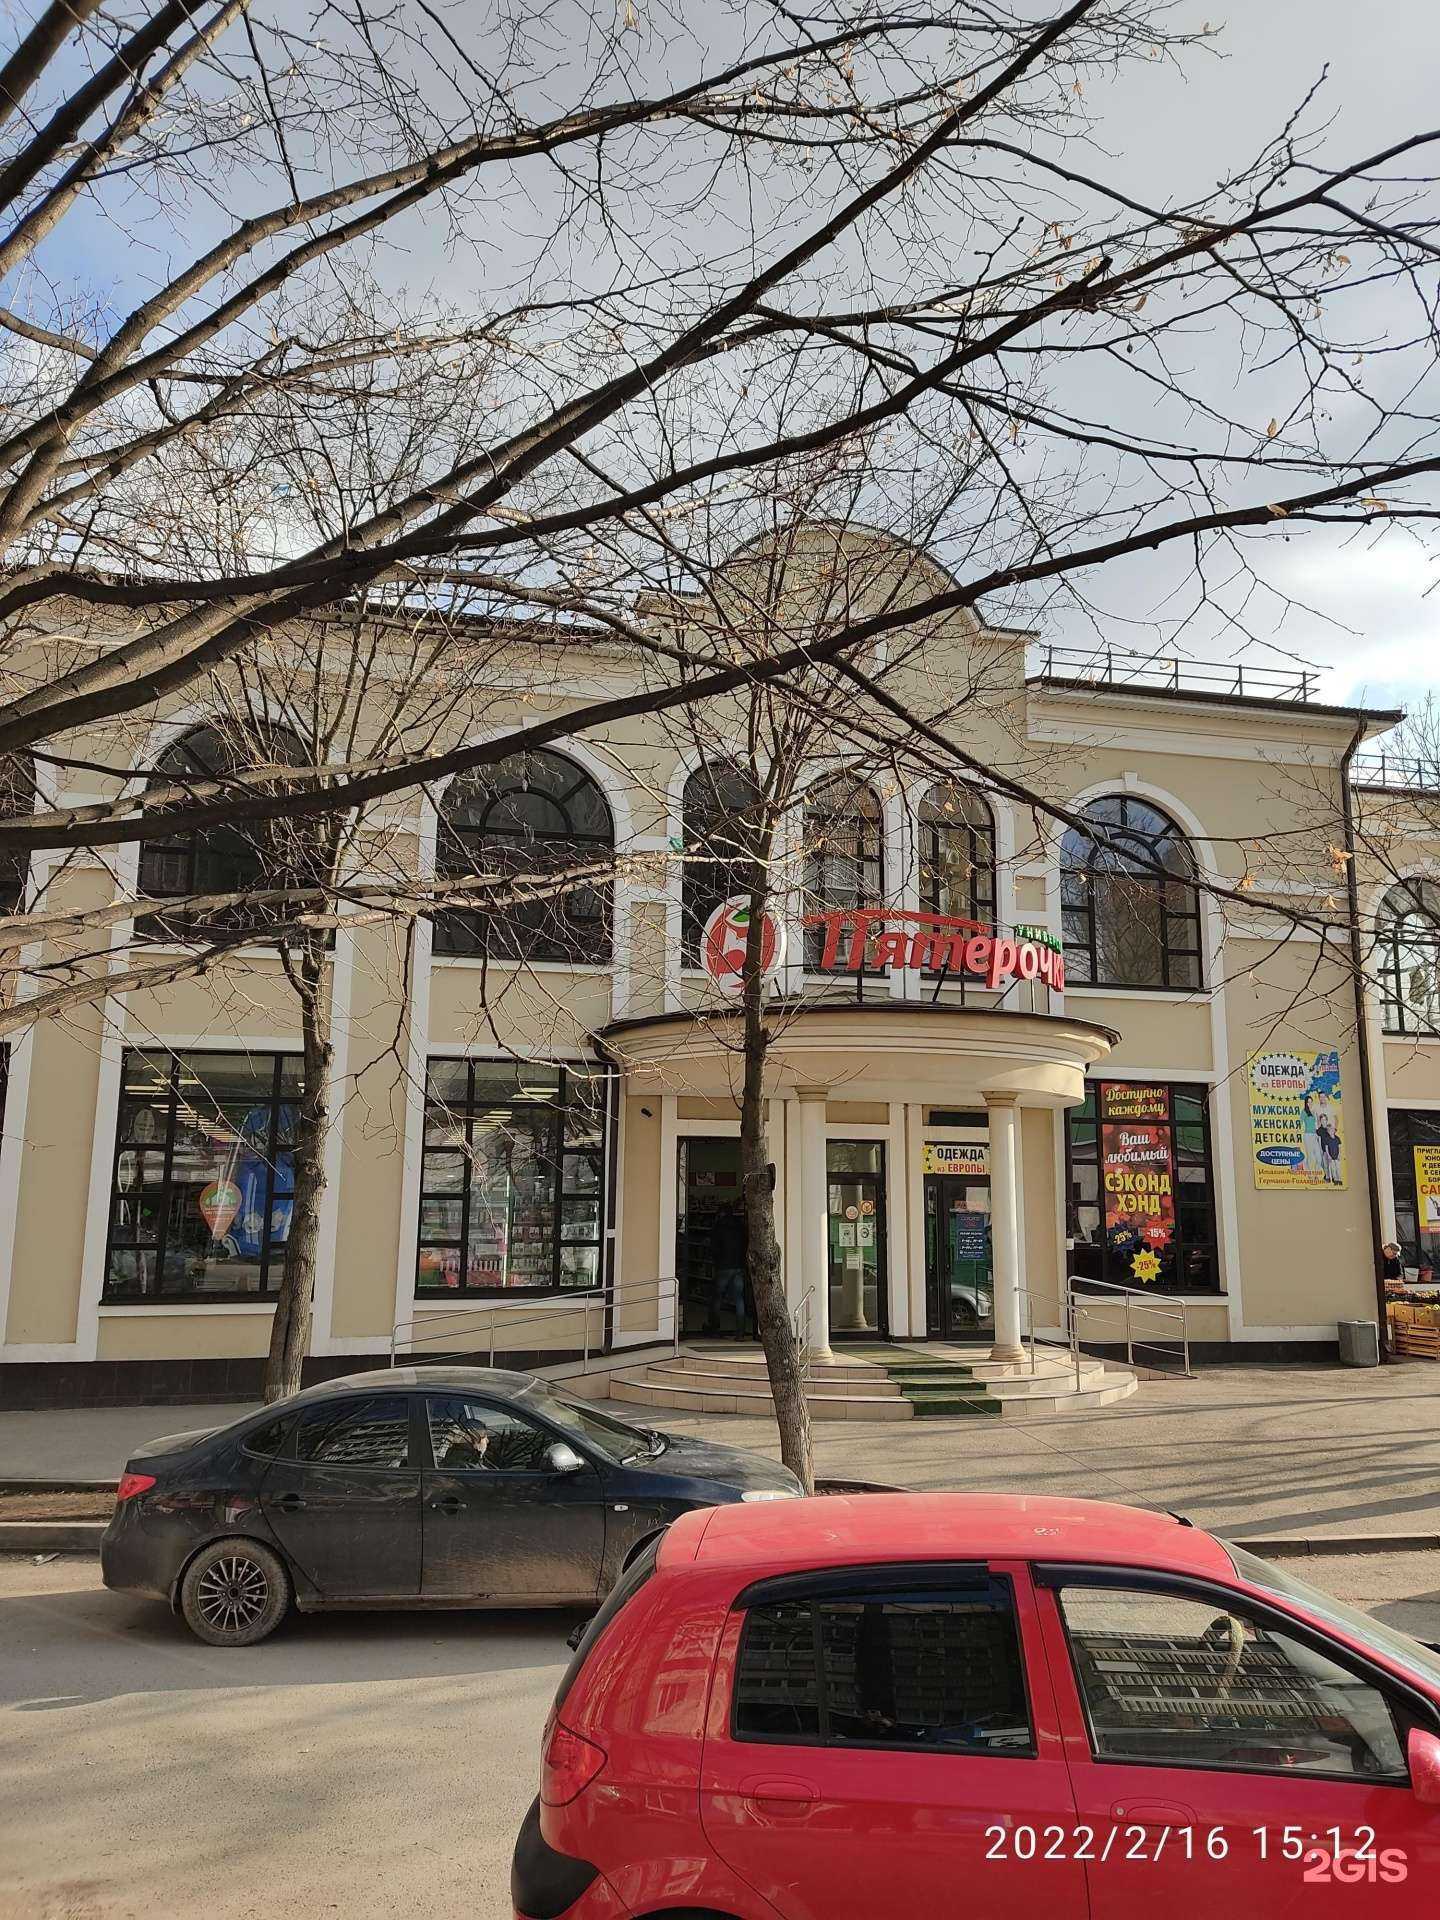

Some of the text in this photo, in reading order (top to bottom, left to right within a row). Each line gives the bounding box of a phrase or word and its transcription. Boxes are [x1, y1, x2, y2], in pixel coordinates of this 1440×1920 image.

[803, 908, 1064, 993] Пятерочк
[1260, 1064, 1304, 1078] ОДЕЖДА
[1271, 1079, 1306, 1089] ЕВРОПЫ
[1105, 1087, 1164, 1103] Доступно
[1108, 1102, 1165, 1118] каждому
[1252, 1105, 1300, 1115] МУЖСКАЯ
[1253, 1119, 1301, 1129] ЖЕНСКАЯ
[1119, 1132, 1150, 1147] Ваш
[1254, 1132, 1303, 1144] ДЕТСКАЯ
[937, 1148, 984, 1161] ОДЕЖДА
[1105, 1146, 1169, 1164] любимый
[948, 1163, 985, 1173] ЕВРОПЫ
[1105, 1173, 1171, 1196] СЭКОНД
[1116, 1194, 1161, 1216] ХЭНД
[1146, 1227, 1166, 1238] -15%
